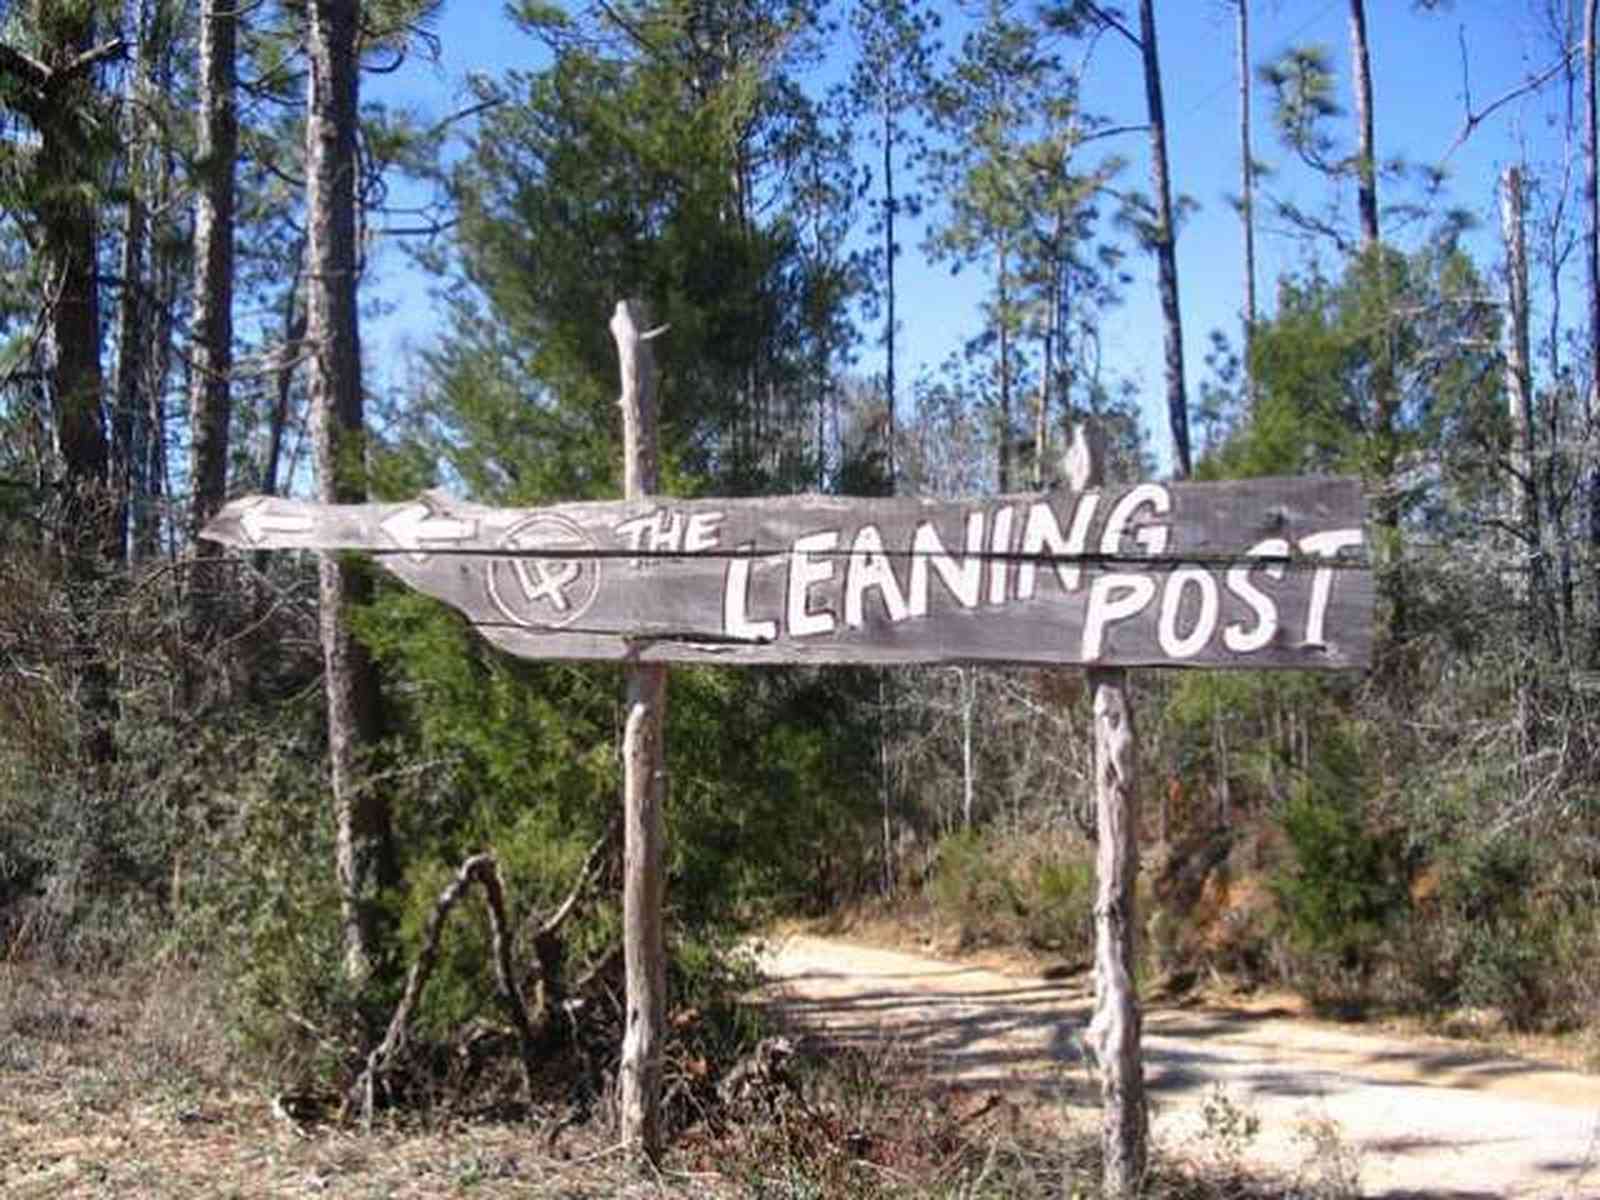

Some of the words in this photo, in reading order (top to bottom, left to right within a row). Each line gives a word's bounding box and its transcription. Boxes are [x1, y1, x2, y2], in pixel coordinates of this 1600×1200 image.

[614, 508, 723, 566] THE
[722, 483, 1171, 641] LEANING
[1081, 528, 1362, 661] POST
